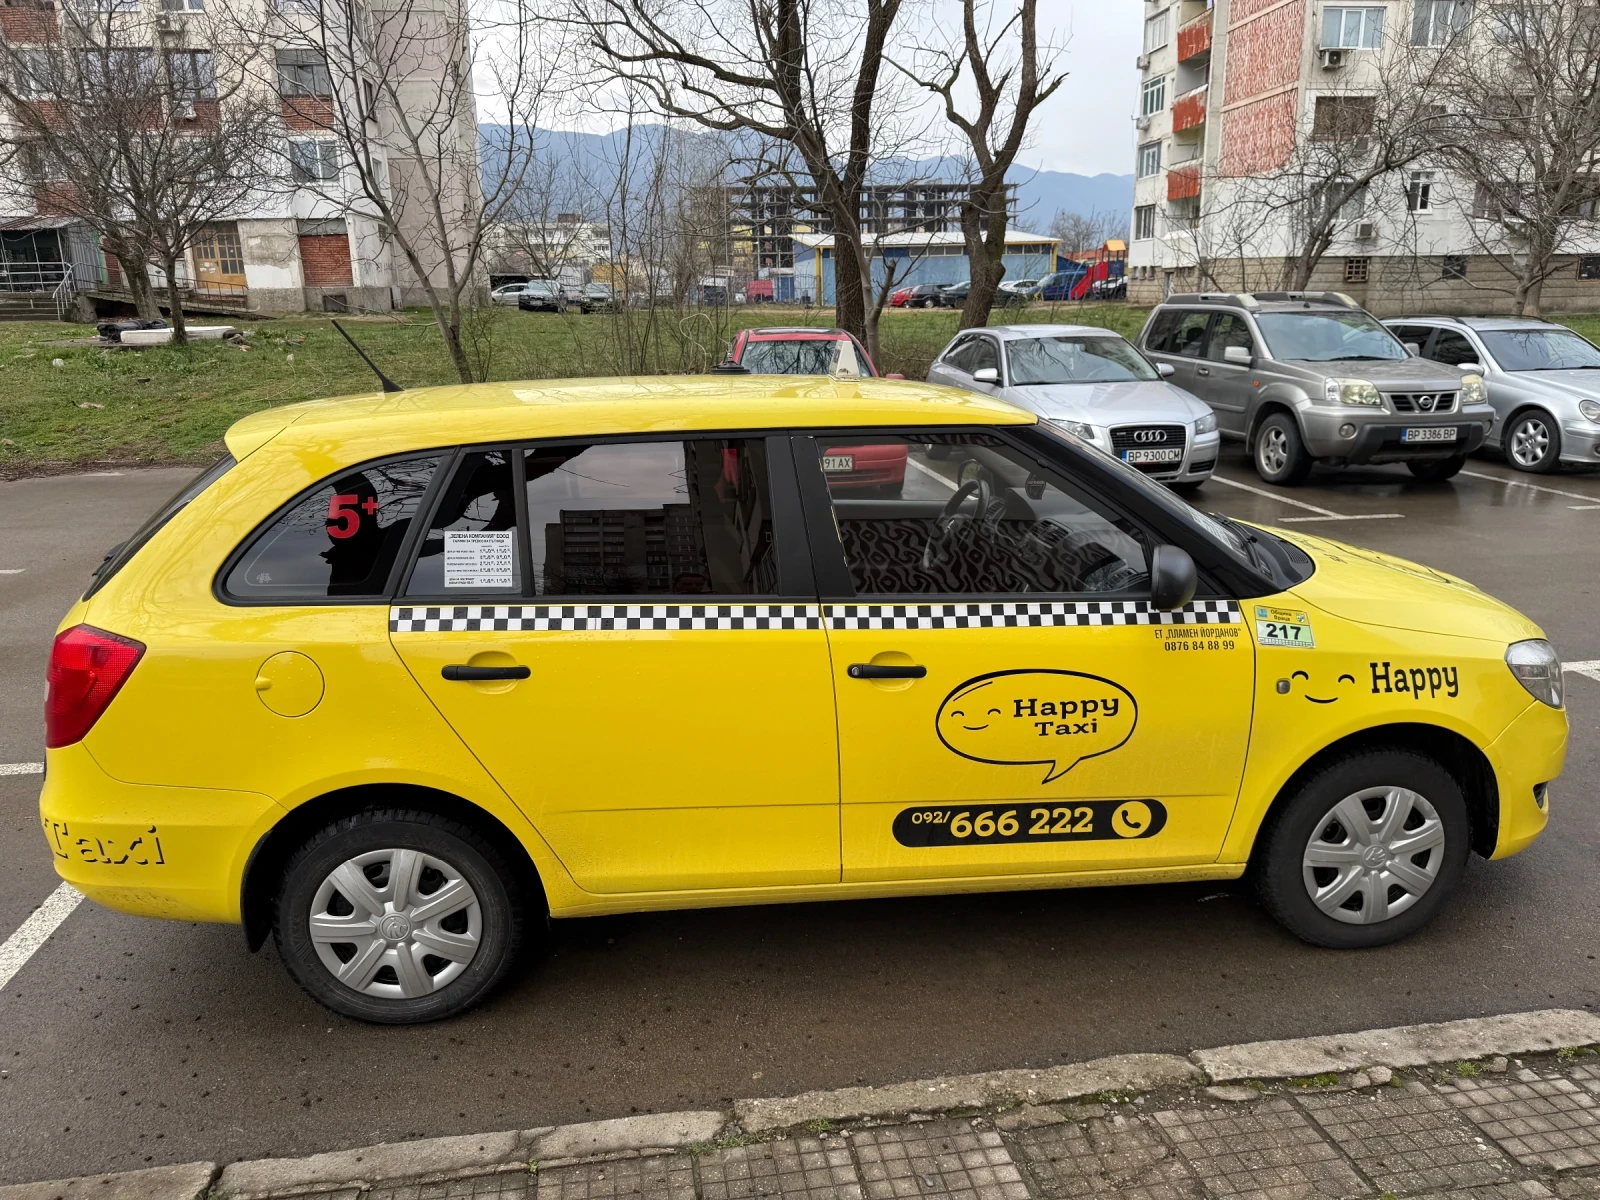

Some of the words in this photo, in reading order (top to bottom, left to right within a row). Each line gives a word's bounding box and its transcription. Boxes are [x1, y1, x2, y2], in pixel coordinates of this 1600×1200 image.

[1408, 430, 1420, 440] BP
[1421, 429, 1442, 439] 3386
[1443, 429, 1456, 439] BP
[1128, 451, 1141, 461] BP
[1143, 450, 1166, 461] 9300
[1168, 449, 1180, 460] CM
[838, 458, 850, 468] AX
[1154, 629, 1163, 639] ЕТ
[1265, 623, 1302, 640] 217
[1164, 641, 1189, 651] 0876
[1192, 641, 1204, 650] 84
[1207, 640, 1219, 650] 88
[1222, 640, 1235, 650] 99
[1369, 661, 1458, 700] Happy
[1013, 698, 1120, 719] Happy
[1034, 718, 1098, 736] Taxi
[1028, 807, 1094, 835] 222
